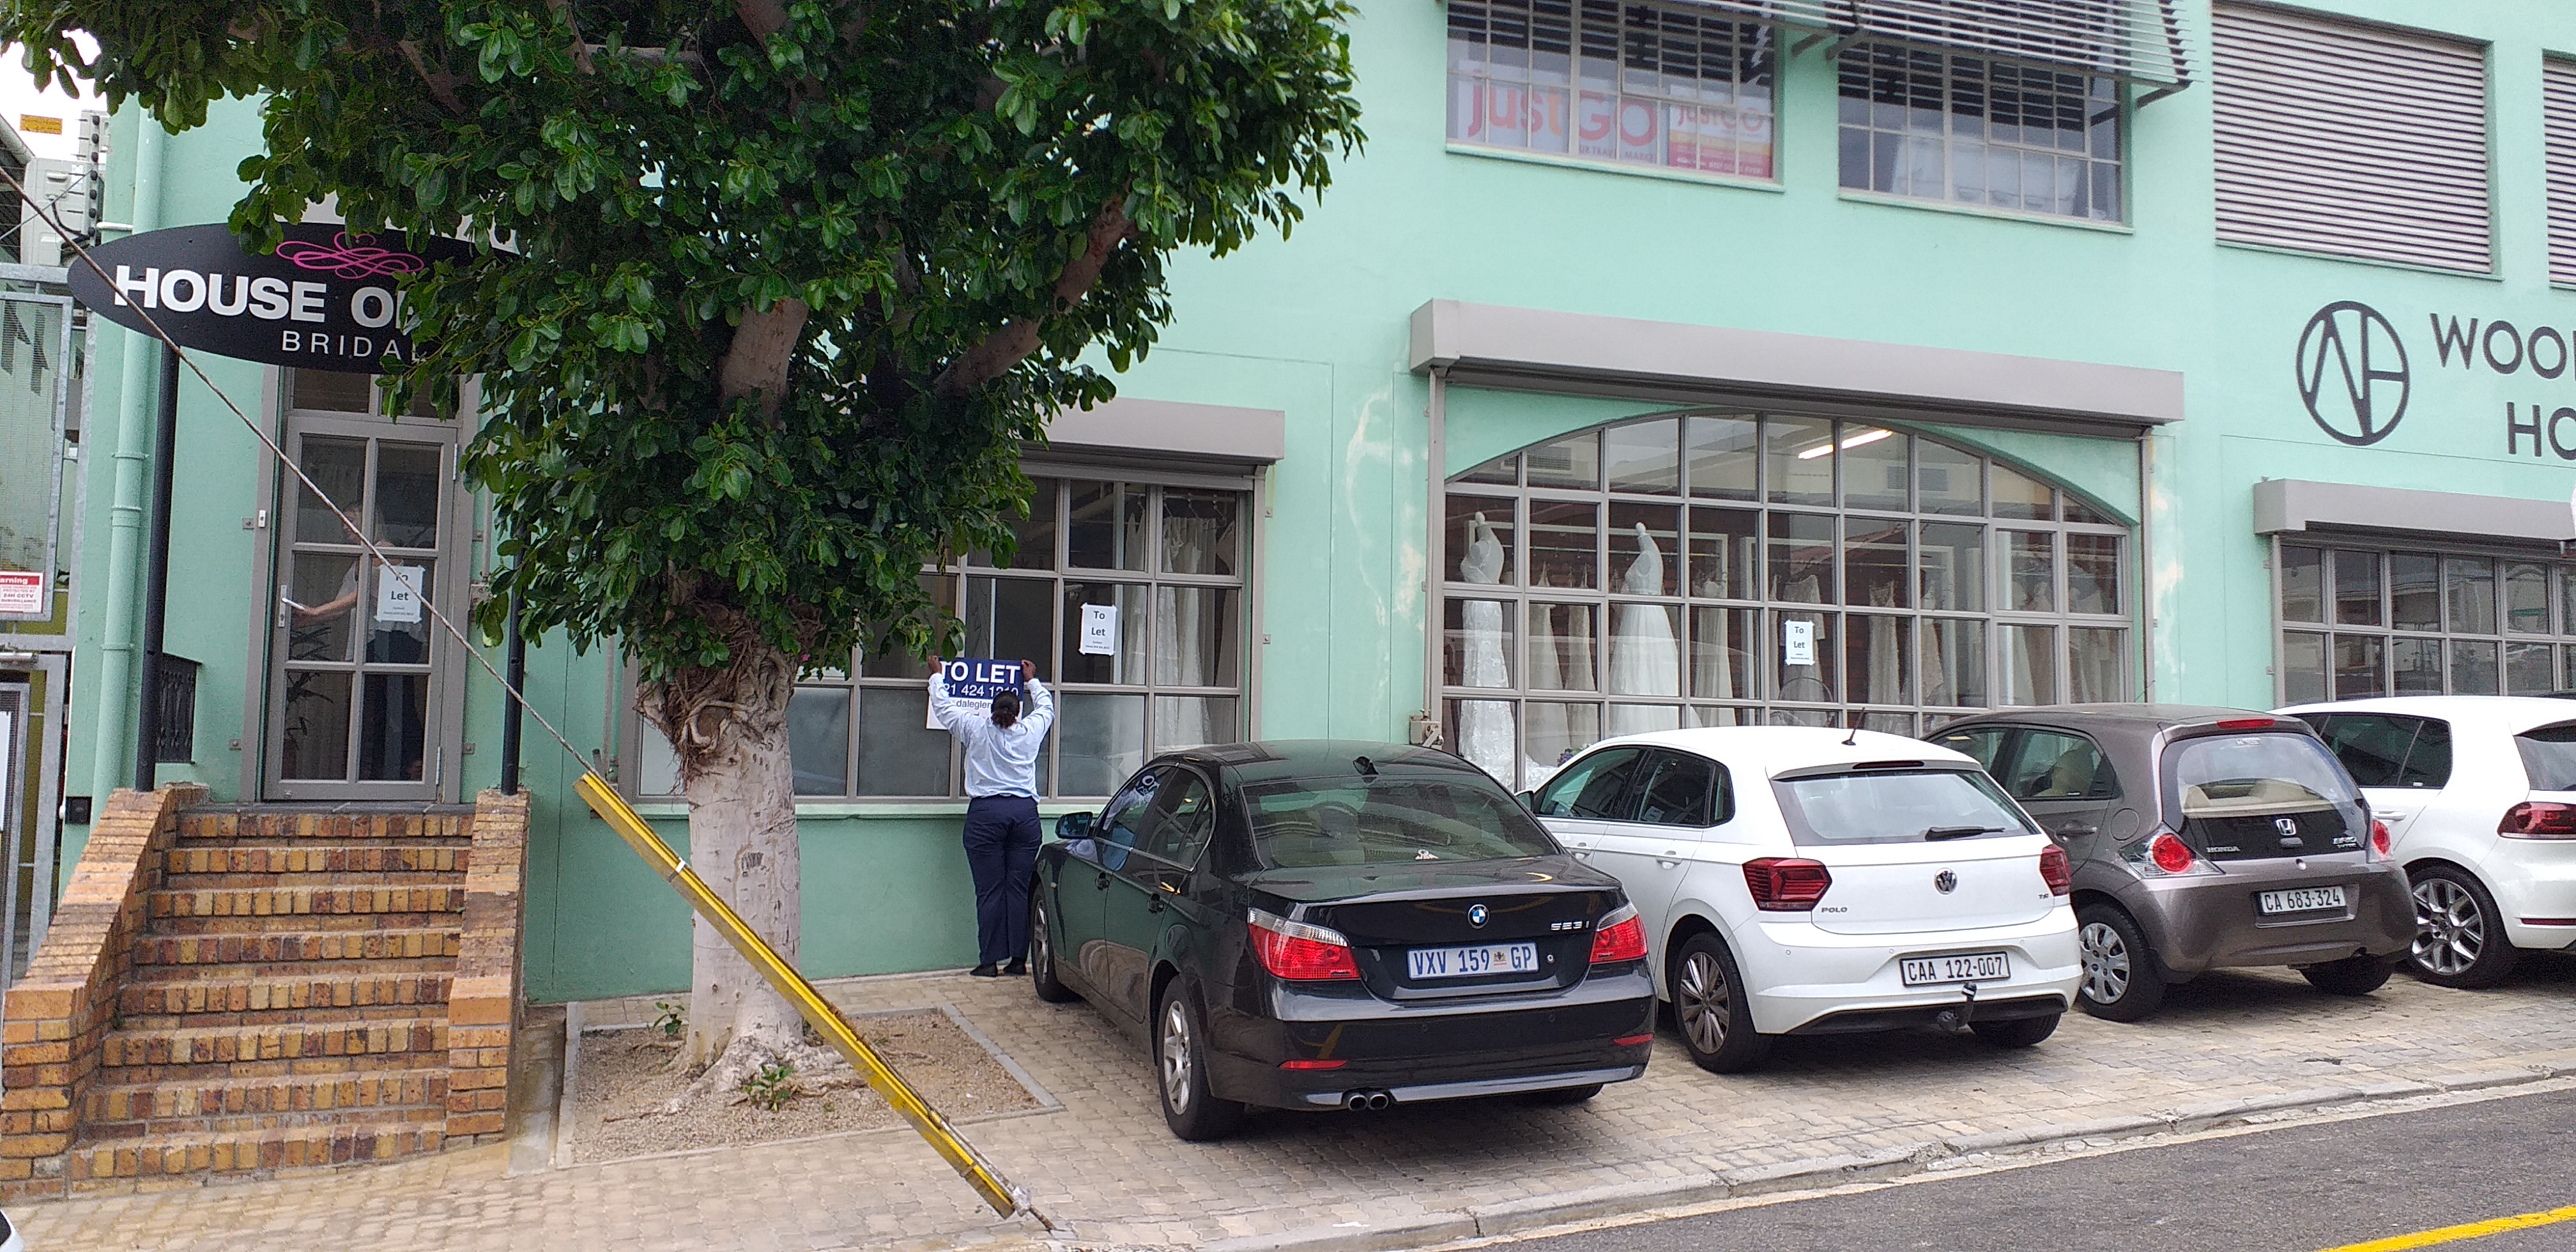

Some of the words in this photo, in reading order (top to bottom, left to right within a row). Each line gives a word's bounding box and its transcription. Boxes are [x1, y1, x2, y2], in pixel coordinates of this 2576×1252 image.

[114, 264, 326, 323] HOUSE
[2429, 312, 2576, 381] WOO
[0, 577, 28, 585] arning
[391, 591, 409, 600] Let
[1094, 611, 1105, 620] To
[1091, 627, 1105, 636] Let
[939, 660, 969, 682] TO
[976, 663, 1021, 684] LET
[961, 684, 985, 697] 424
[2264, 894, 2282, 911] CA
[2287, 889, 2341, 908] 683-324
[1414, 951, 1446, 975] VXV
[1458, 949, 1490, 972] 159
[1510, 946, 1531, 969] GP
[1908, 961, 1937, 981] CAA
[1945, 957, 2002, 978] 122-007
